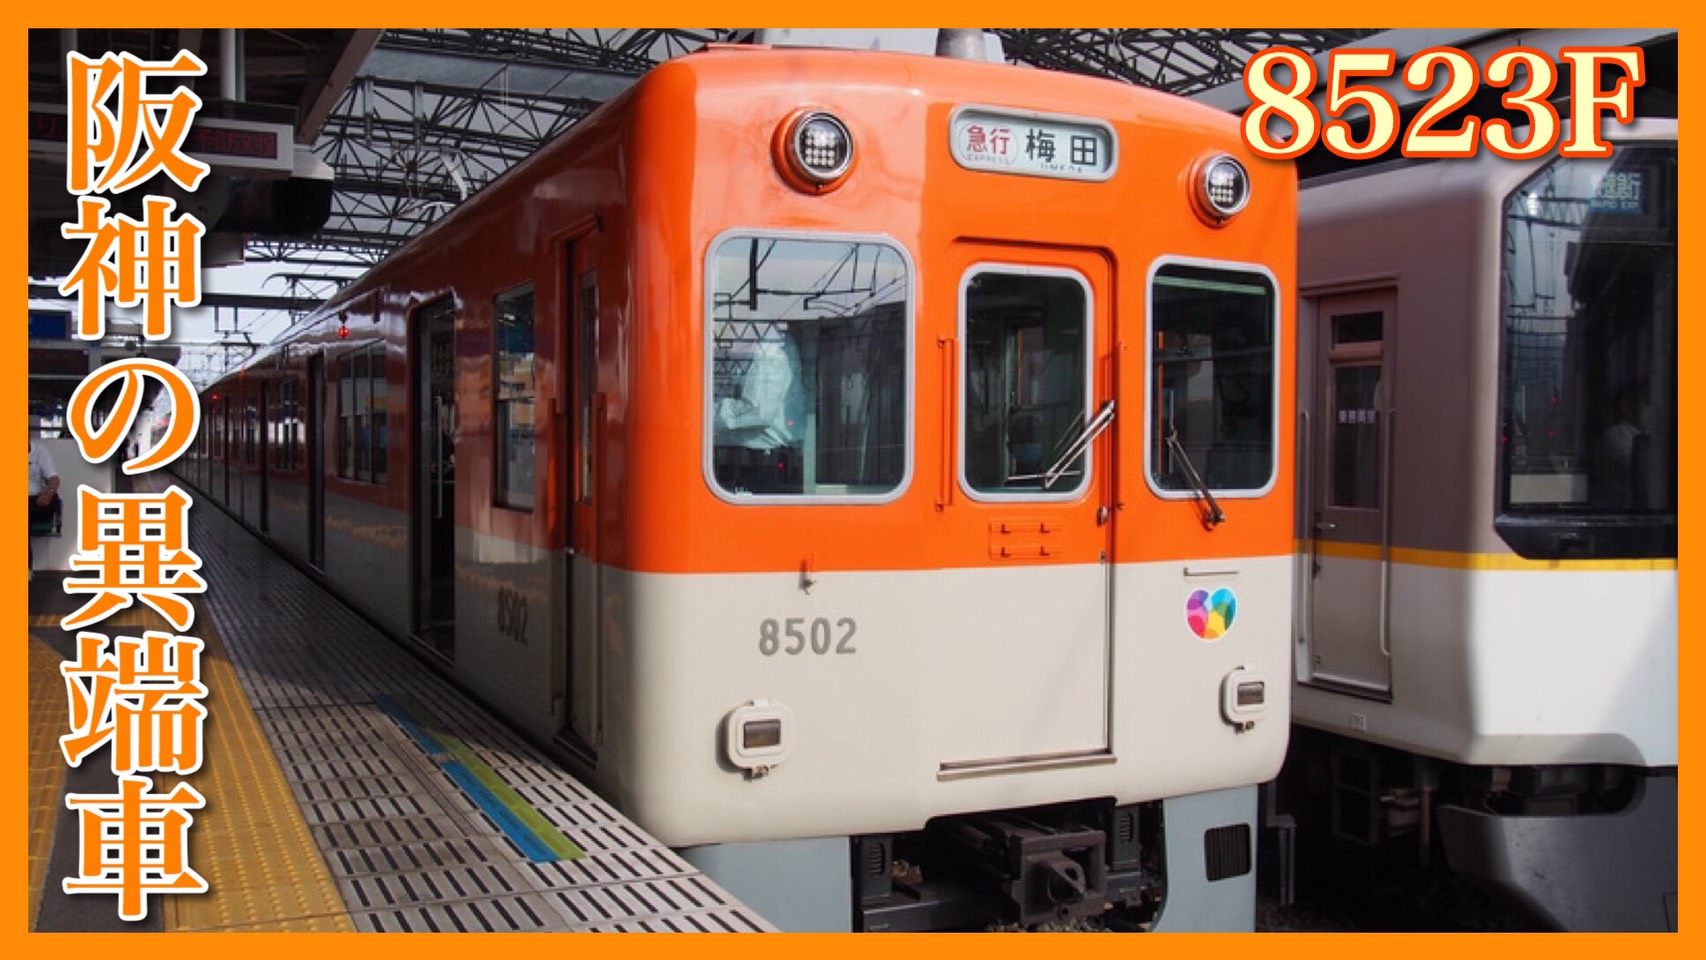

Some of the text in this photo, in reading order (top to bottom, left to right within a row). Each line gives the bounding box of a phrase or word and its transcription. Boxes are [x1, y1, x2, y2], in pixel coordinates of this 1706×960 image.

[966, 124, 1012, 155] 急行
[1025, 128, 1098, 166] 梅田
[497, 585, 529, 646] 8502
[757, 616, 858, 657] 8502
